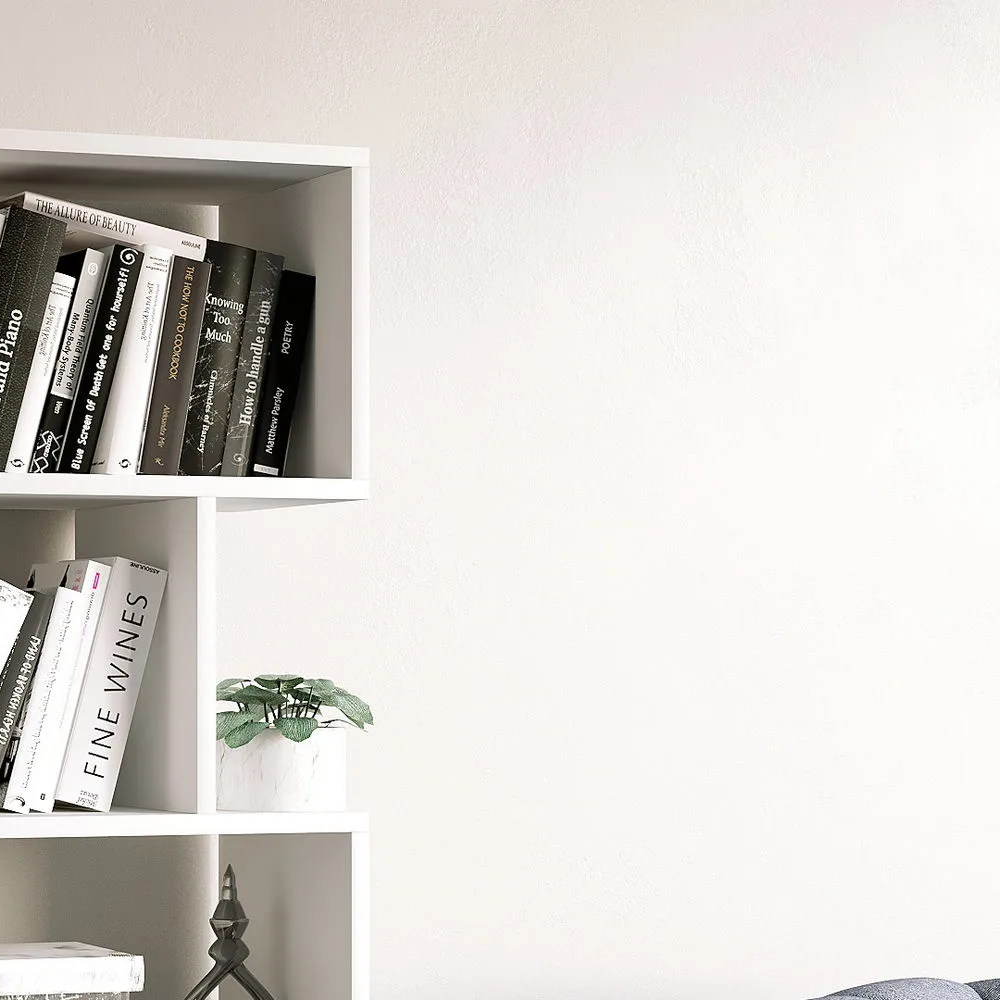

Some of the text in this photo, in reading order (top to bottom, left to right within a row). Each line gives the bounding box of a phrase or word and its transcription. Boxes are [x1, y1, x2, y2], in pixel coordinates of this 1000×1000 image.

[35, 198, 136, 236] THE ALLURE OF BEAUTY
[168, 265, 194, 379] THE HOW NOT TO COOKBOOK
[204, 292, 244, 314] Knowing
[212, 310, 231, 327] Too
[61, 312, 80, 354] Many-Body
[64, 298, 93, 391] Quantum Field Theory of
[205, 325, 232, 344] Much
[281, 320, 294, 354] POETRY
[53, 355, 69, 387] Systems
[70, 266, 129, 470] Blue Screen Of Death Get one for hourself!
[238, 300, 272, 425] How to handle a gun
[196, 369, 219, 453] Chronicles of Barney
[270, 386, 284, 415] Parsley
[264, 418, 278, 453] Matthew
[82, 707, 120, 777] FINE
[103, 592, 149, 696] WINES
